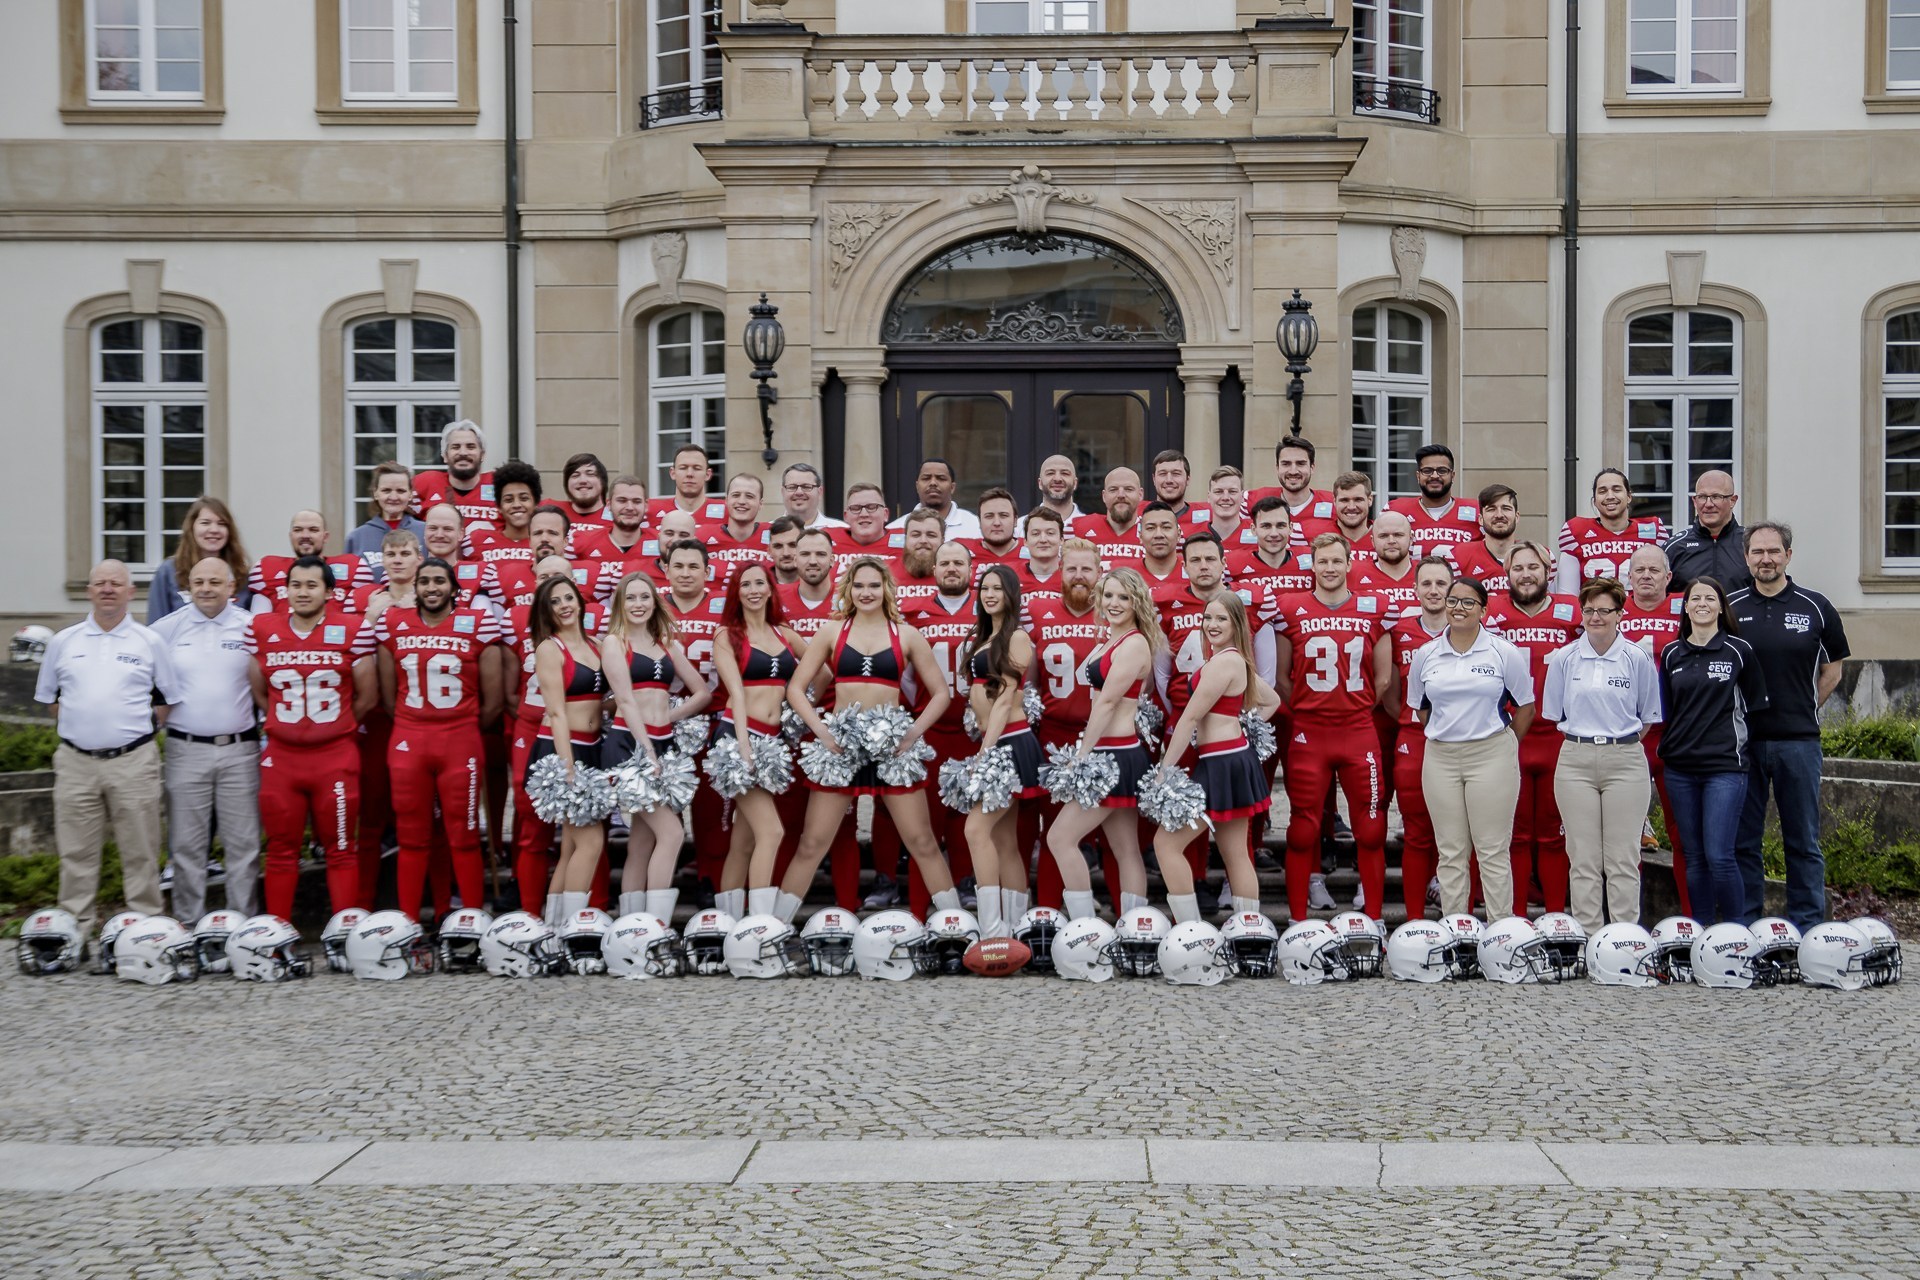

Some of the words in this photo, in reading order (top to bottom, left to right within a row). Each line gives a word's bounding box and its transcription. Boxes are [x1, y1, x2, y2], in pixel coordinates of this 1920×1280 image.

[482, 548, 535, 563] ROCKE
[1097, 543, 1148, 559] OCKETS
[1300, 617, 1372, 634] ROCKETS
[395, 635, 471, 653] ROCKETS
[266, 651, 343, 667] ROCKETS
[1304, 635, 1364, 692] 31
[400, 653, 463, 709] 16
[269, 669, 341, 724] 36
[982, 953, 1007, 961] Wilson
